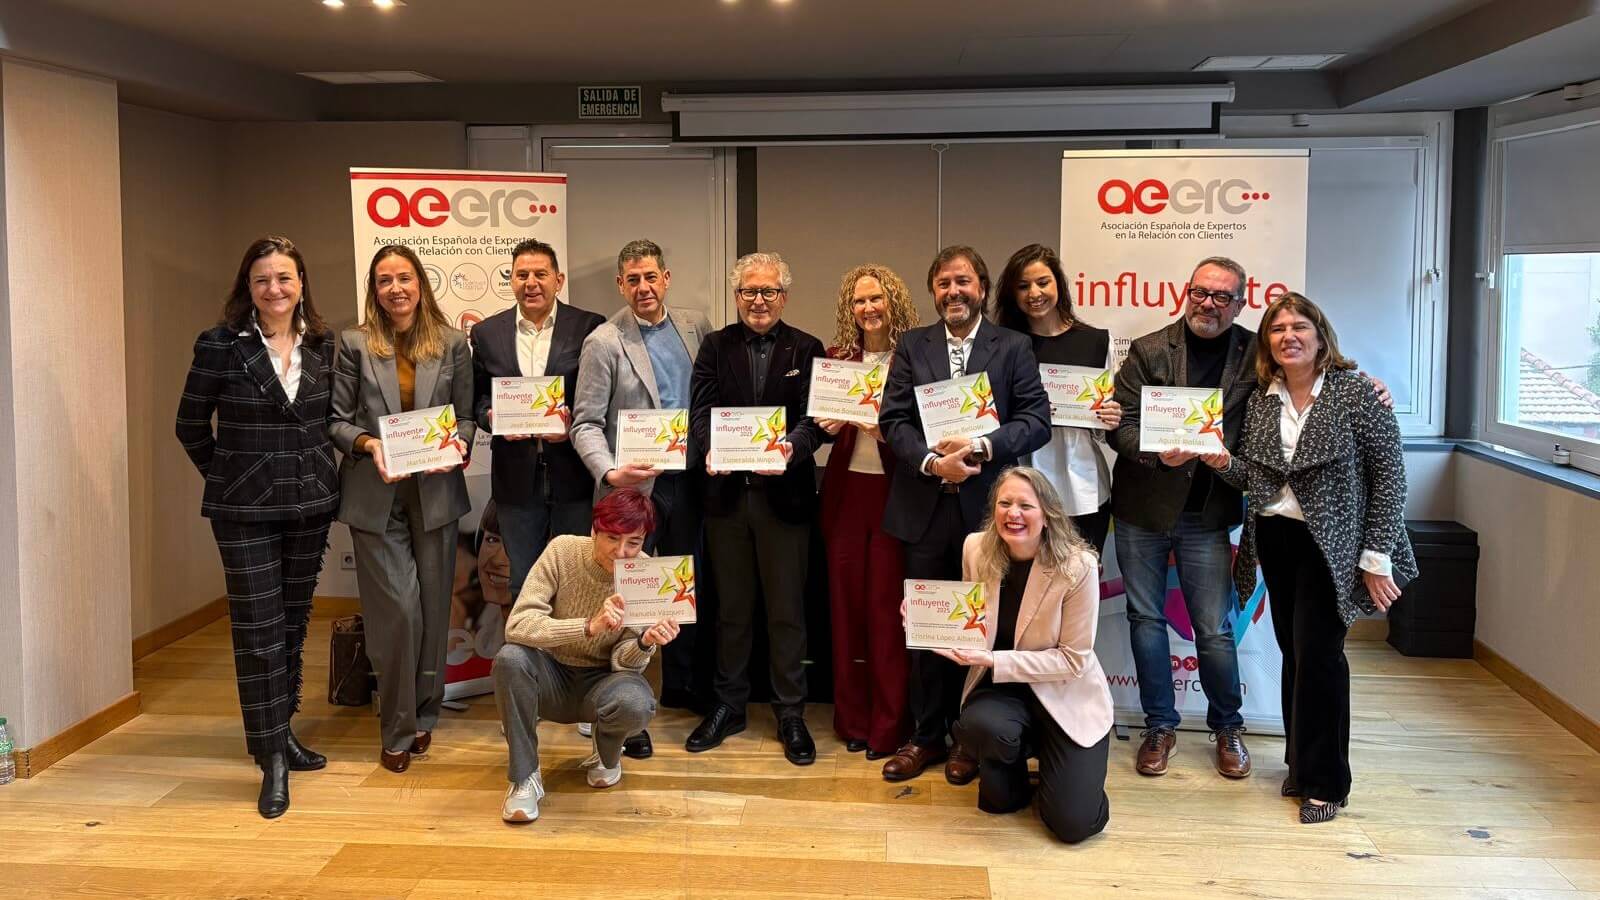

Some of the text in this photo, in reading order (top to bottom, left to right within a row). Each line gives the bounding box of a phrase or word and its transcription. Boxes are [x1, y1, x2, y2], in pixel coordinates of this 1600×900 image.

[583, 89, 637, 101] SALIDA DE
[581, 103, 639, 115] EMERGENCIA
[1100, 221, 1247, 231] Asociación Española de Expertos
[1115, 230, 1234, 240] en la Relación con Clientes
[373, 235, 430, 246] Asociación
[432, 235, 478, 247] Española
[480, 235, 493, 245] de
[419, 246, 461, 256] Relación
[465, 248, 483, 256] con
[485, 246, 514, 256] Client
[1075, 272, 1289, 316] influyte
[815, 375, 851, 385] influyente
[496, 391, 533, 400] influyente
[922, 397, 960, 409] influyente
[1145, 405, 1186, 414] influyente
[386, 427, 425, 439] influyente
[623, 425, 657, 433] influyente
[715, 424, 753, 433] influyente
[620, 576, 660, 585] influyente
[910, 598, 951, 608] influyente
